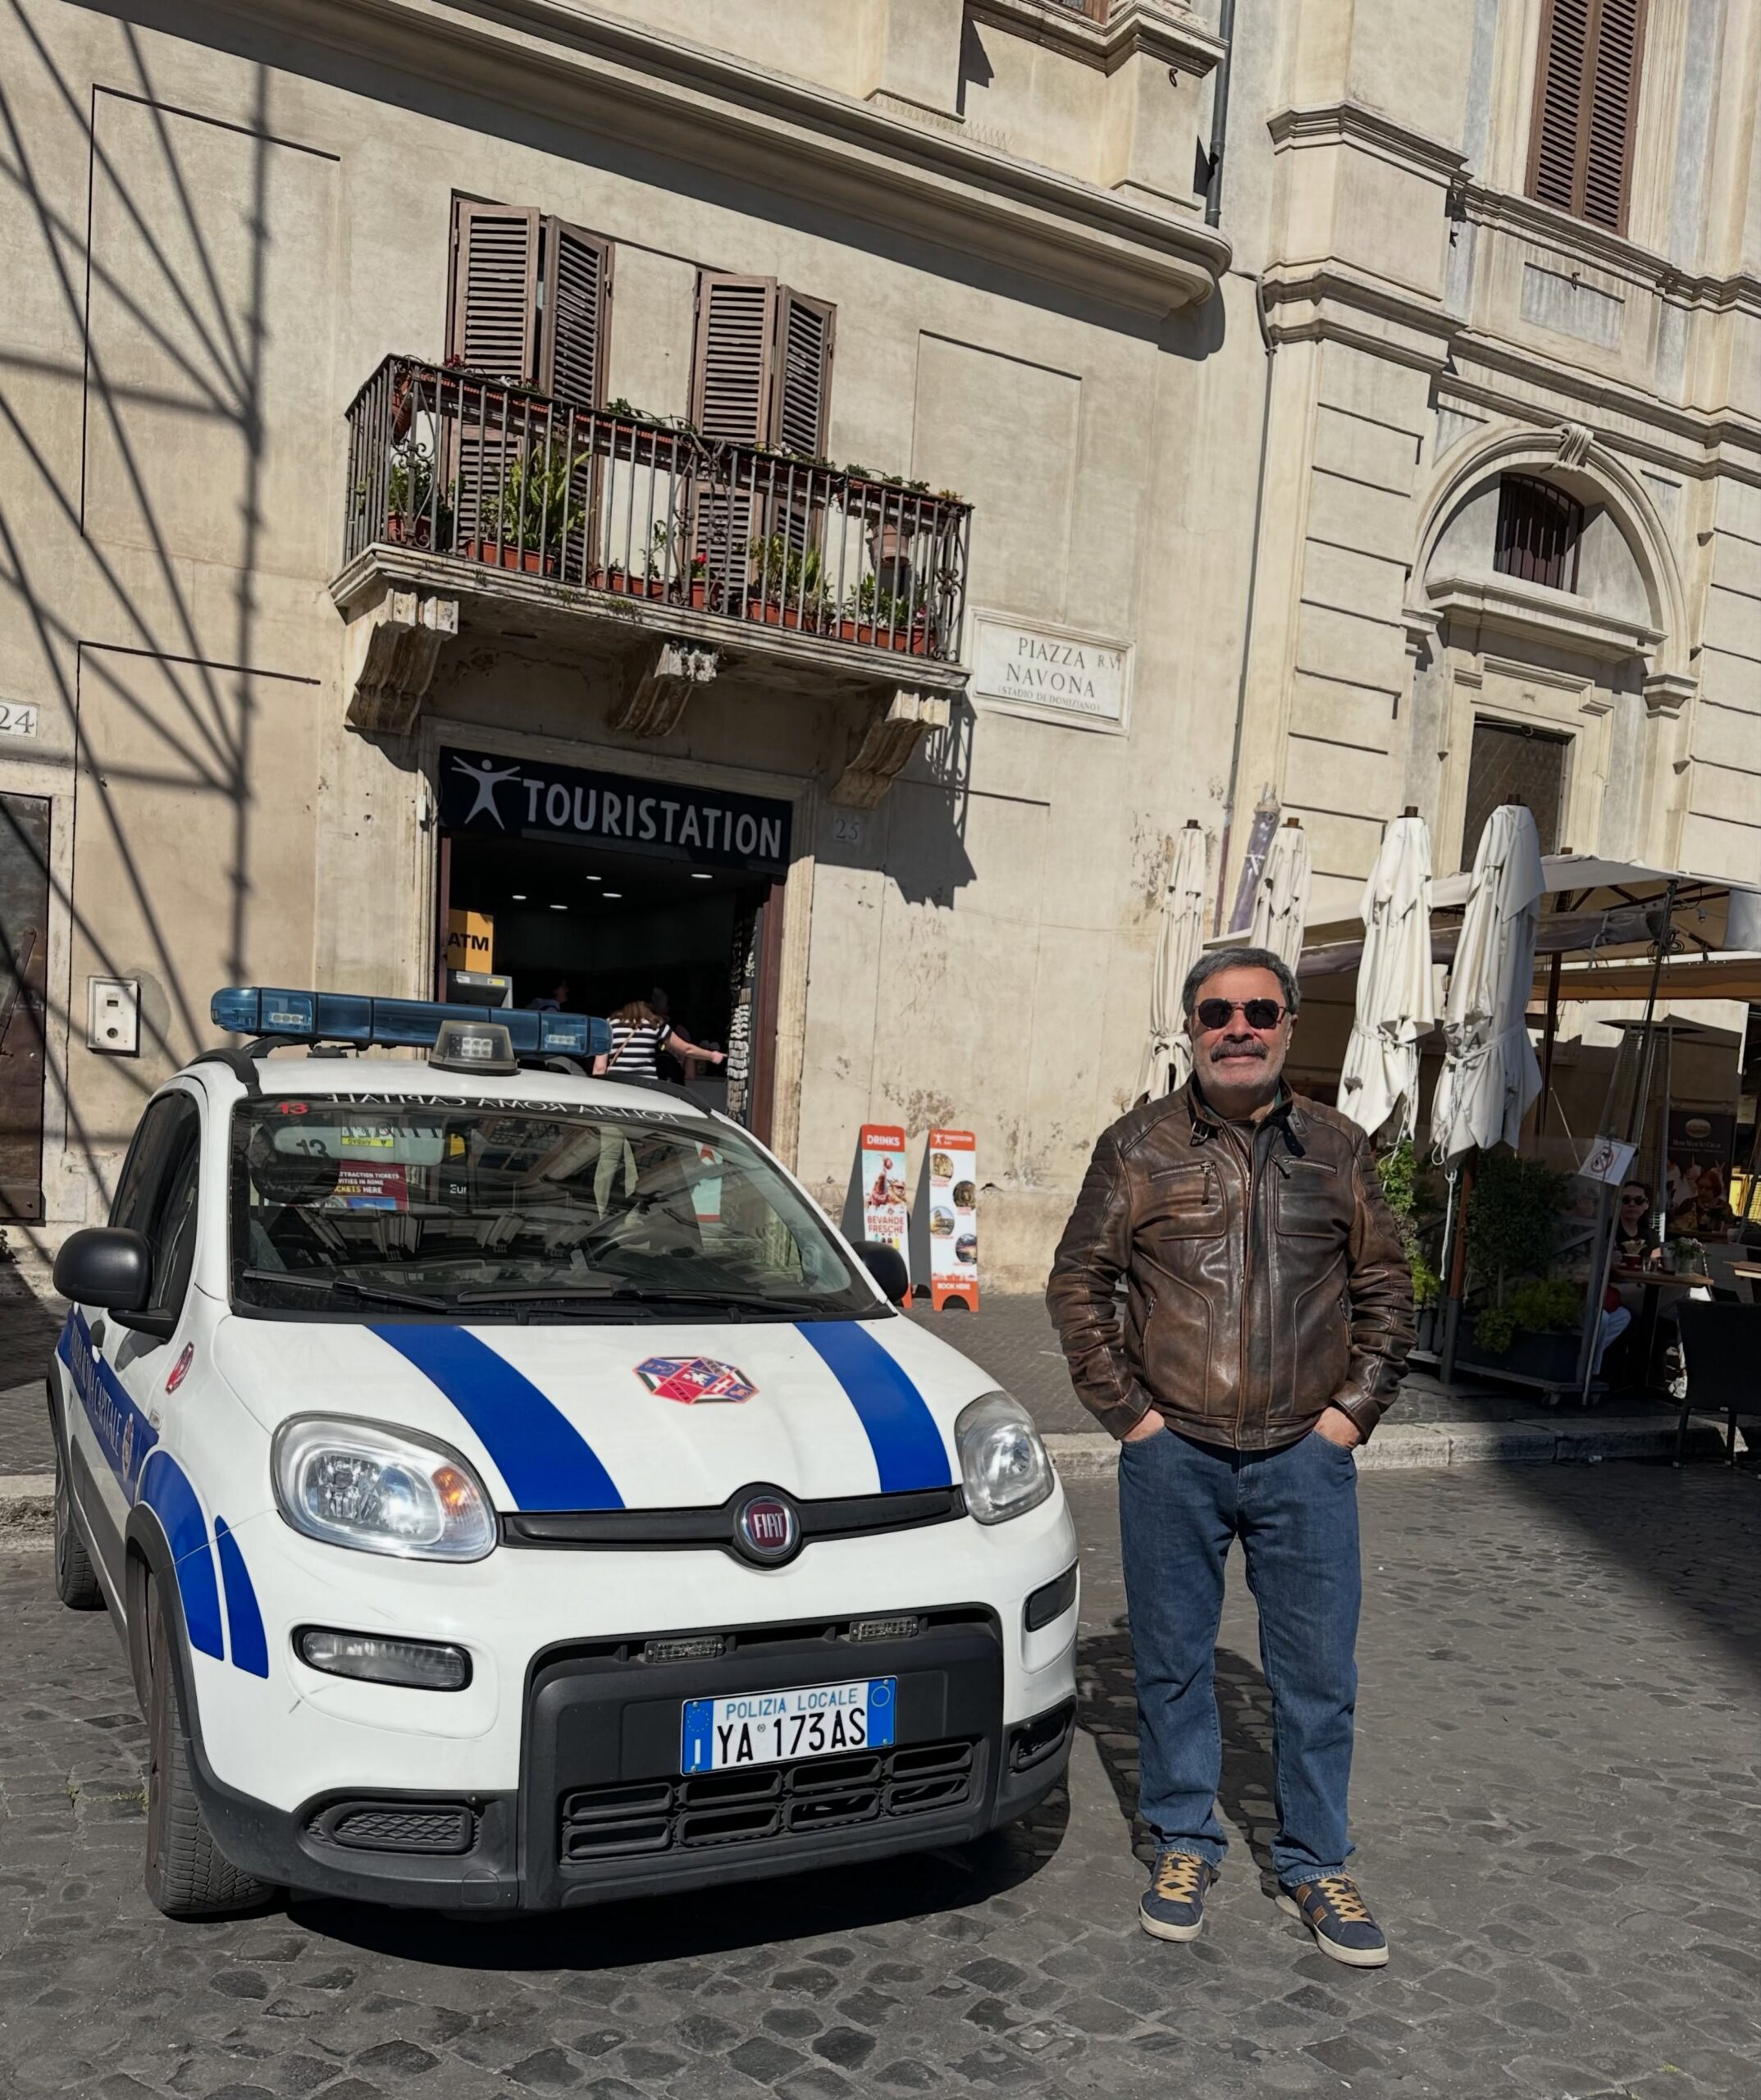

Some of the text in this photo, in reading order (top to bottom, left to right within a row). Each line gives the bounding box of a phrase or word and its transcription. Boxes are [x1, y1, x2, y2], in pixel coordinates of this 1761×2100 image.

[1018, 637, 1085, 669] PIAZZA
[1006, 663, 1095, 697] NAVONA
[0, 705, 34, 733] 24
[521, 778, 782, 859] TOURISTATION
[836, 818, 860, 841] 25
[448, 932, 490, 952] ATM
[276, 1102, 308, 1115] 13
[866, 1134, 901, 1147] DRINKS
[867, 1216, 904, 1225] BEVANDE
[868, 1225, 904, 1234] FRESCHE
[94, 1376, 122, 1458] CAPITALE
[753, 1512, 784, 1539] FIAT
[726, 1688, 859, 1720] POLIZIA LOCALE
[717, 1723, 754, 1764] YA
[773, 1707, 866, 1757] 173AS
